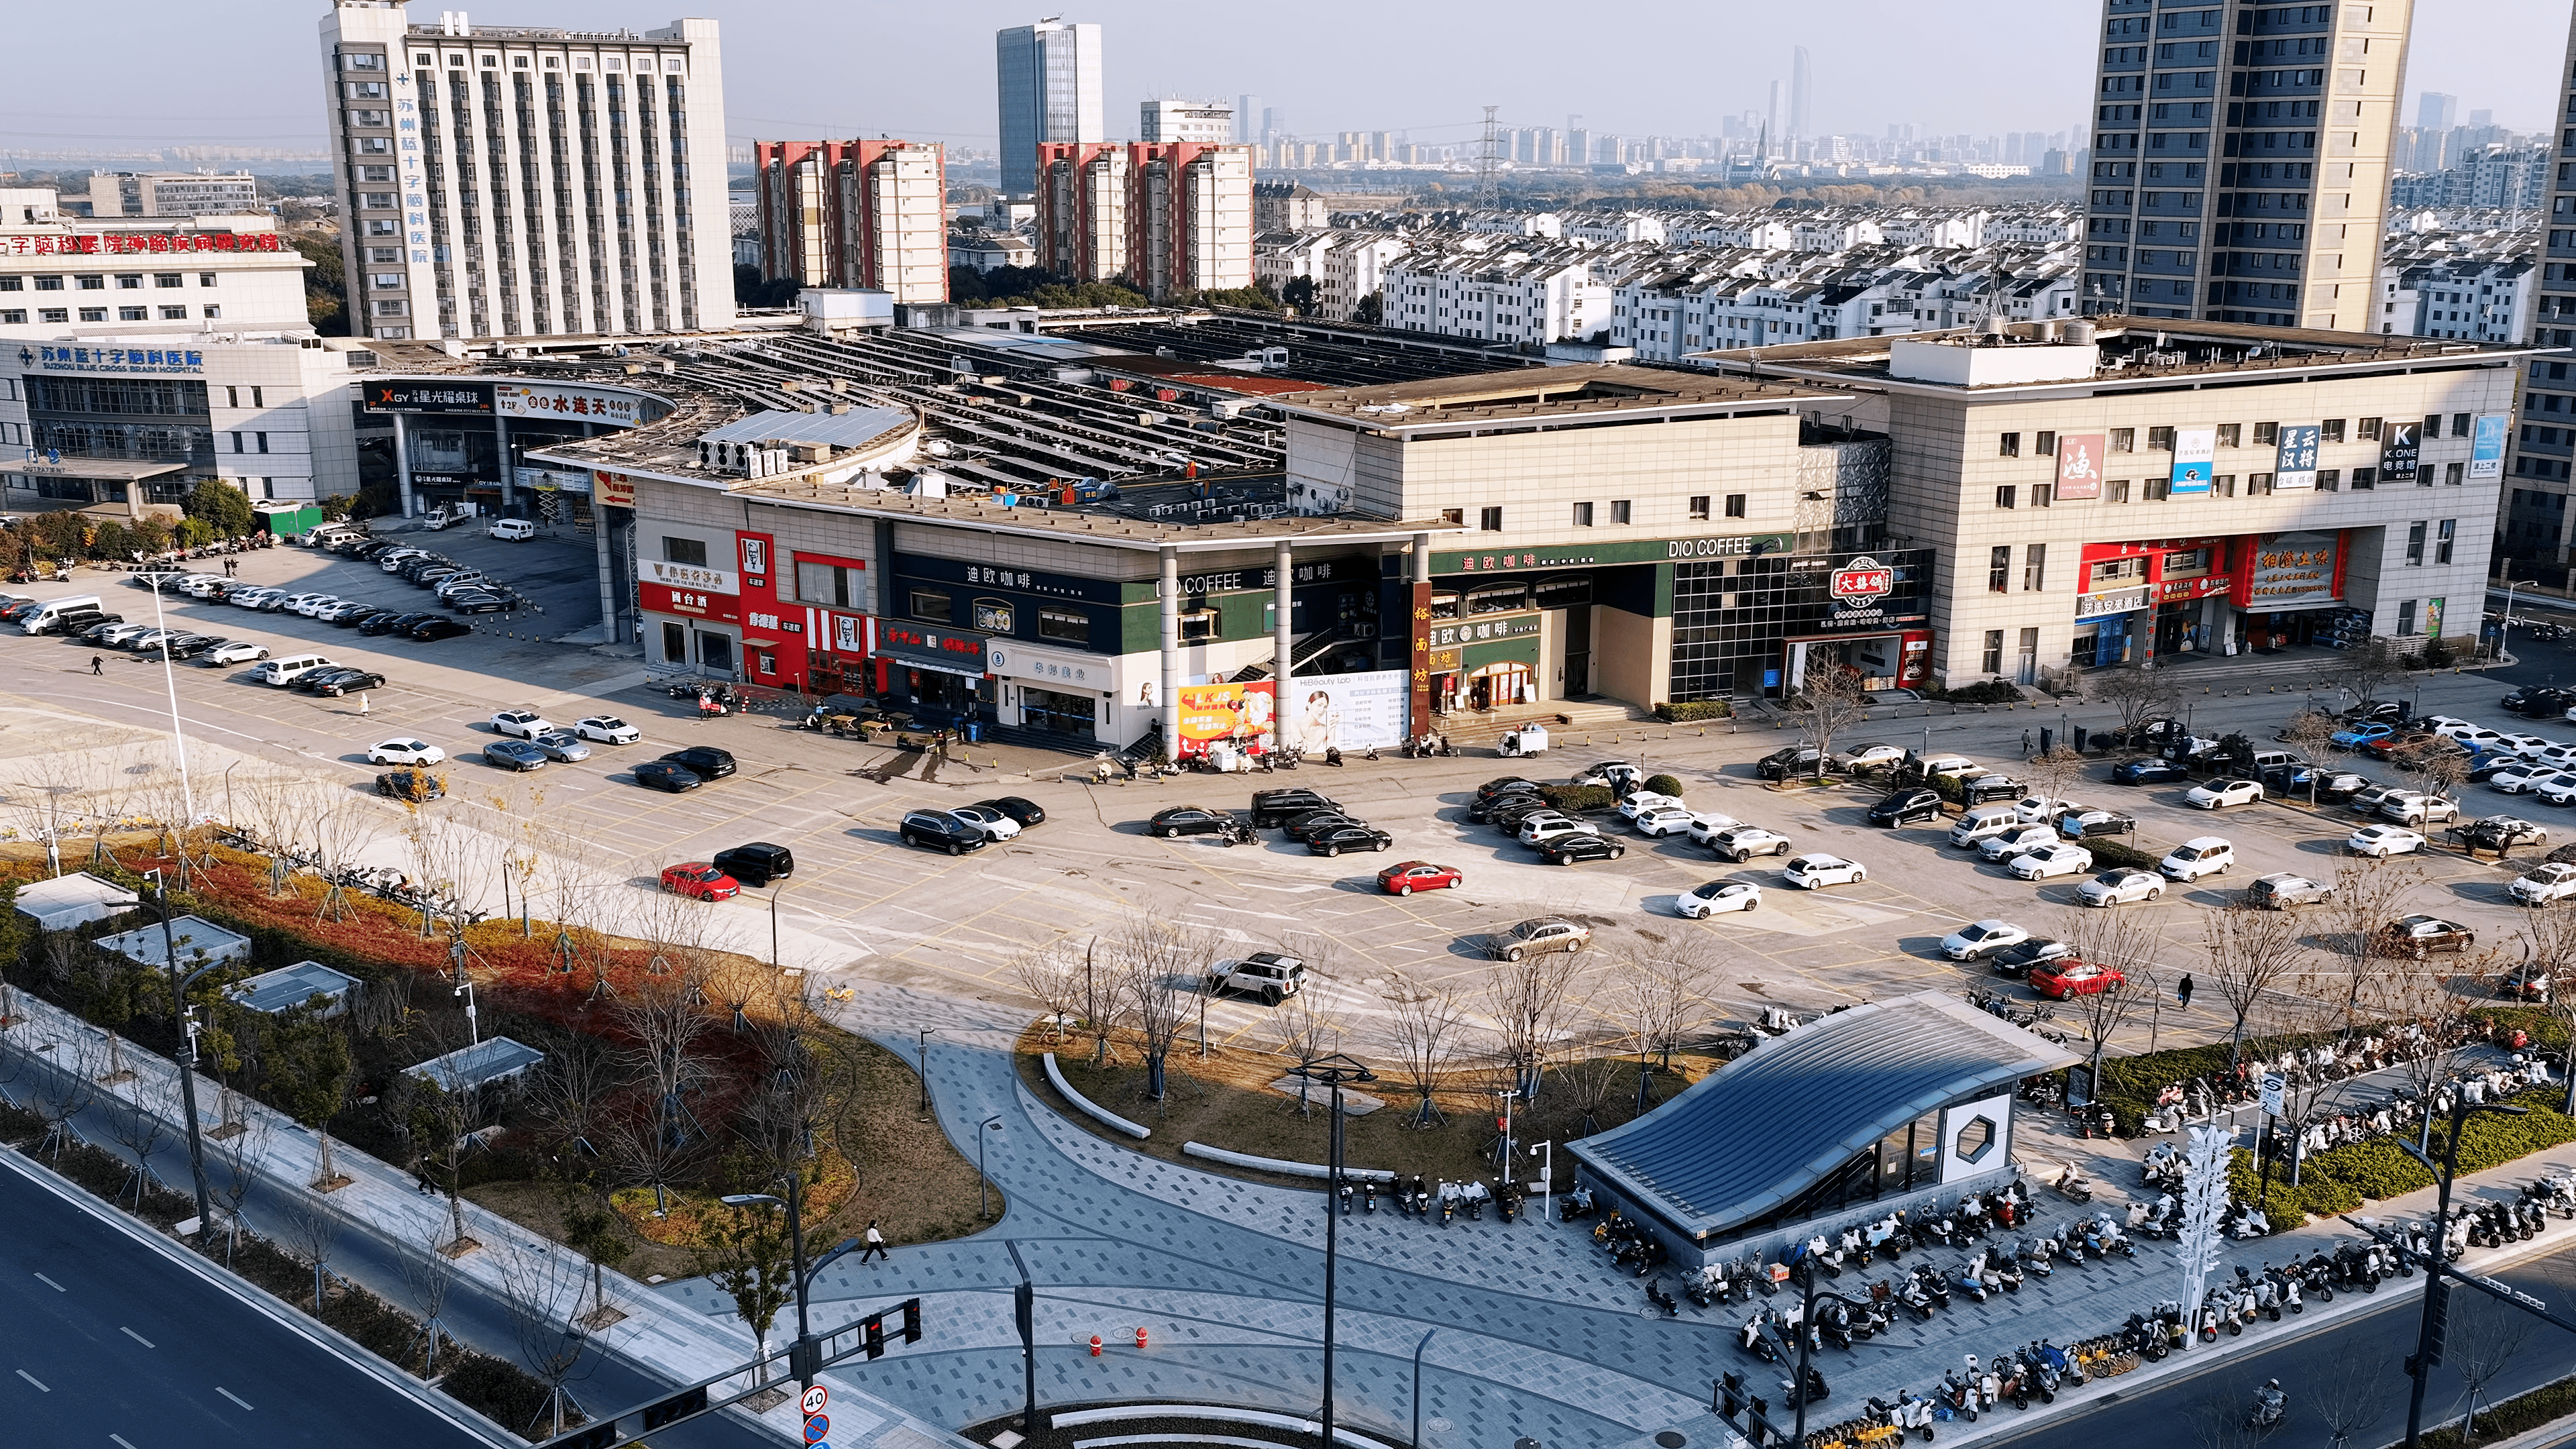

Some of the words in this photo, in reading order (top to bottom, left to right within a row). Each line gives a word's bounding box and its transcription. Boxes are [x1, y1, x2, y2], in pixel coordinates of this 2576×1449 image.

[397, 99, 428, 263] 苏州蓝十字脑科医院
[40, 346, 204, 366] 苏州蓝十字脑科医院
[43, 362, 75, 370] SUZHOU
[77, 363, 97, 371] BLUE
[99, 364, 127, 372] CROSS
[129, 366, 157, 374] BRAIN
[160, 366, 204, 374] HOSPITAL
[381, 389, 409, 402] XGY
[419, 390, 478, 404] 星光耀桌球
[506, 401, 517, 410] 2F
[2394, 425, 2412, 445] K
[2383, 460, 2416, 471] 电竞馆
[1668, 541, 1693, 557] DIO
[1697, 537, 1752, 555] COFFEE
[1462, 554, 1535, 570] 迪欧咖啡
[967, 566, 1030, 588] 迪欧咖啡
[1185, 573, 1241, 594] COFFEE
[1263, 564, 1331, 586] 迪咖啡
[2082, 596, 2143, 615] 艺选安来酒店
[749, 612, 779, 630] 肯德基
[1413, 607, 1430, 682] 裕面坊
[806, 1392, 823, 1407] 40
